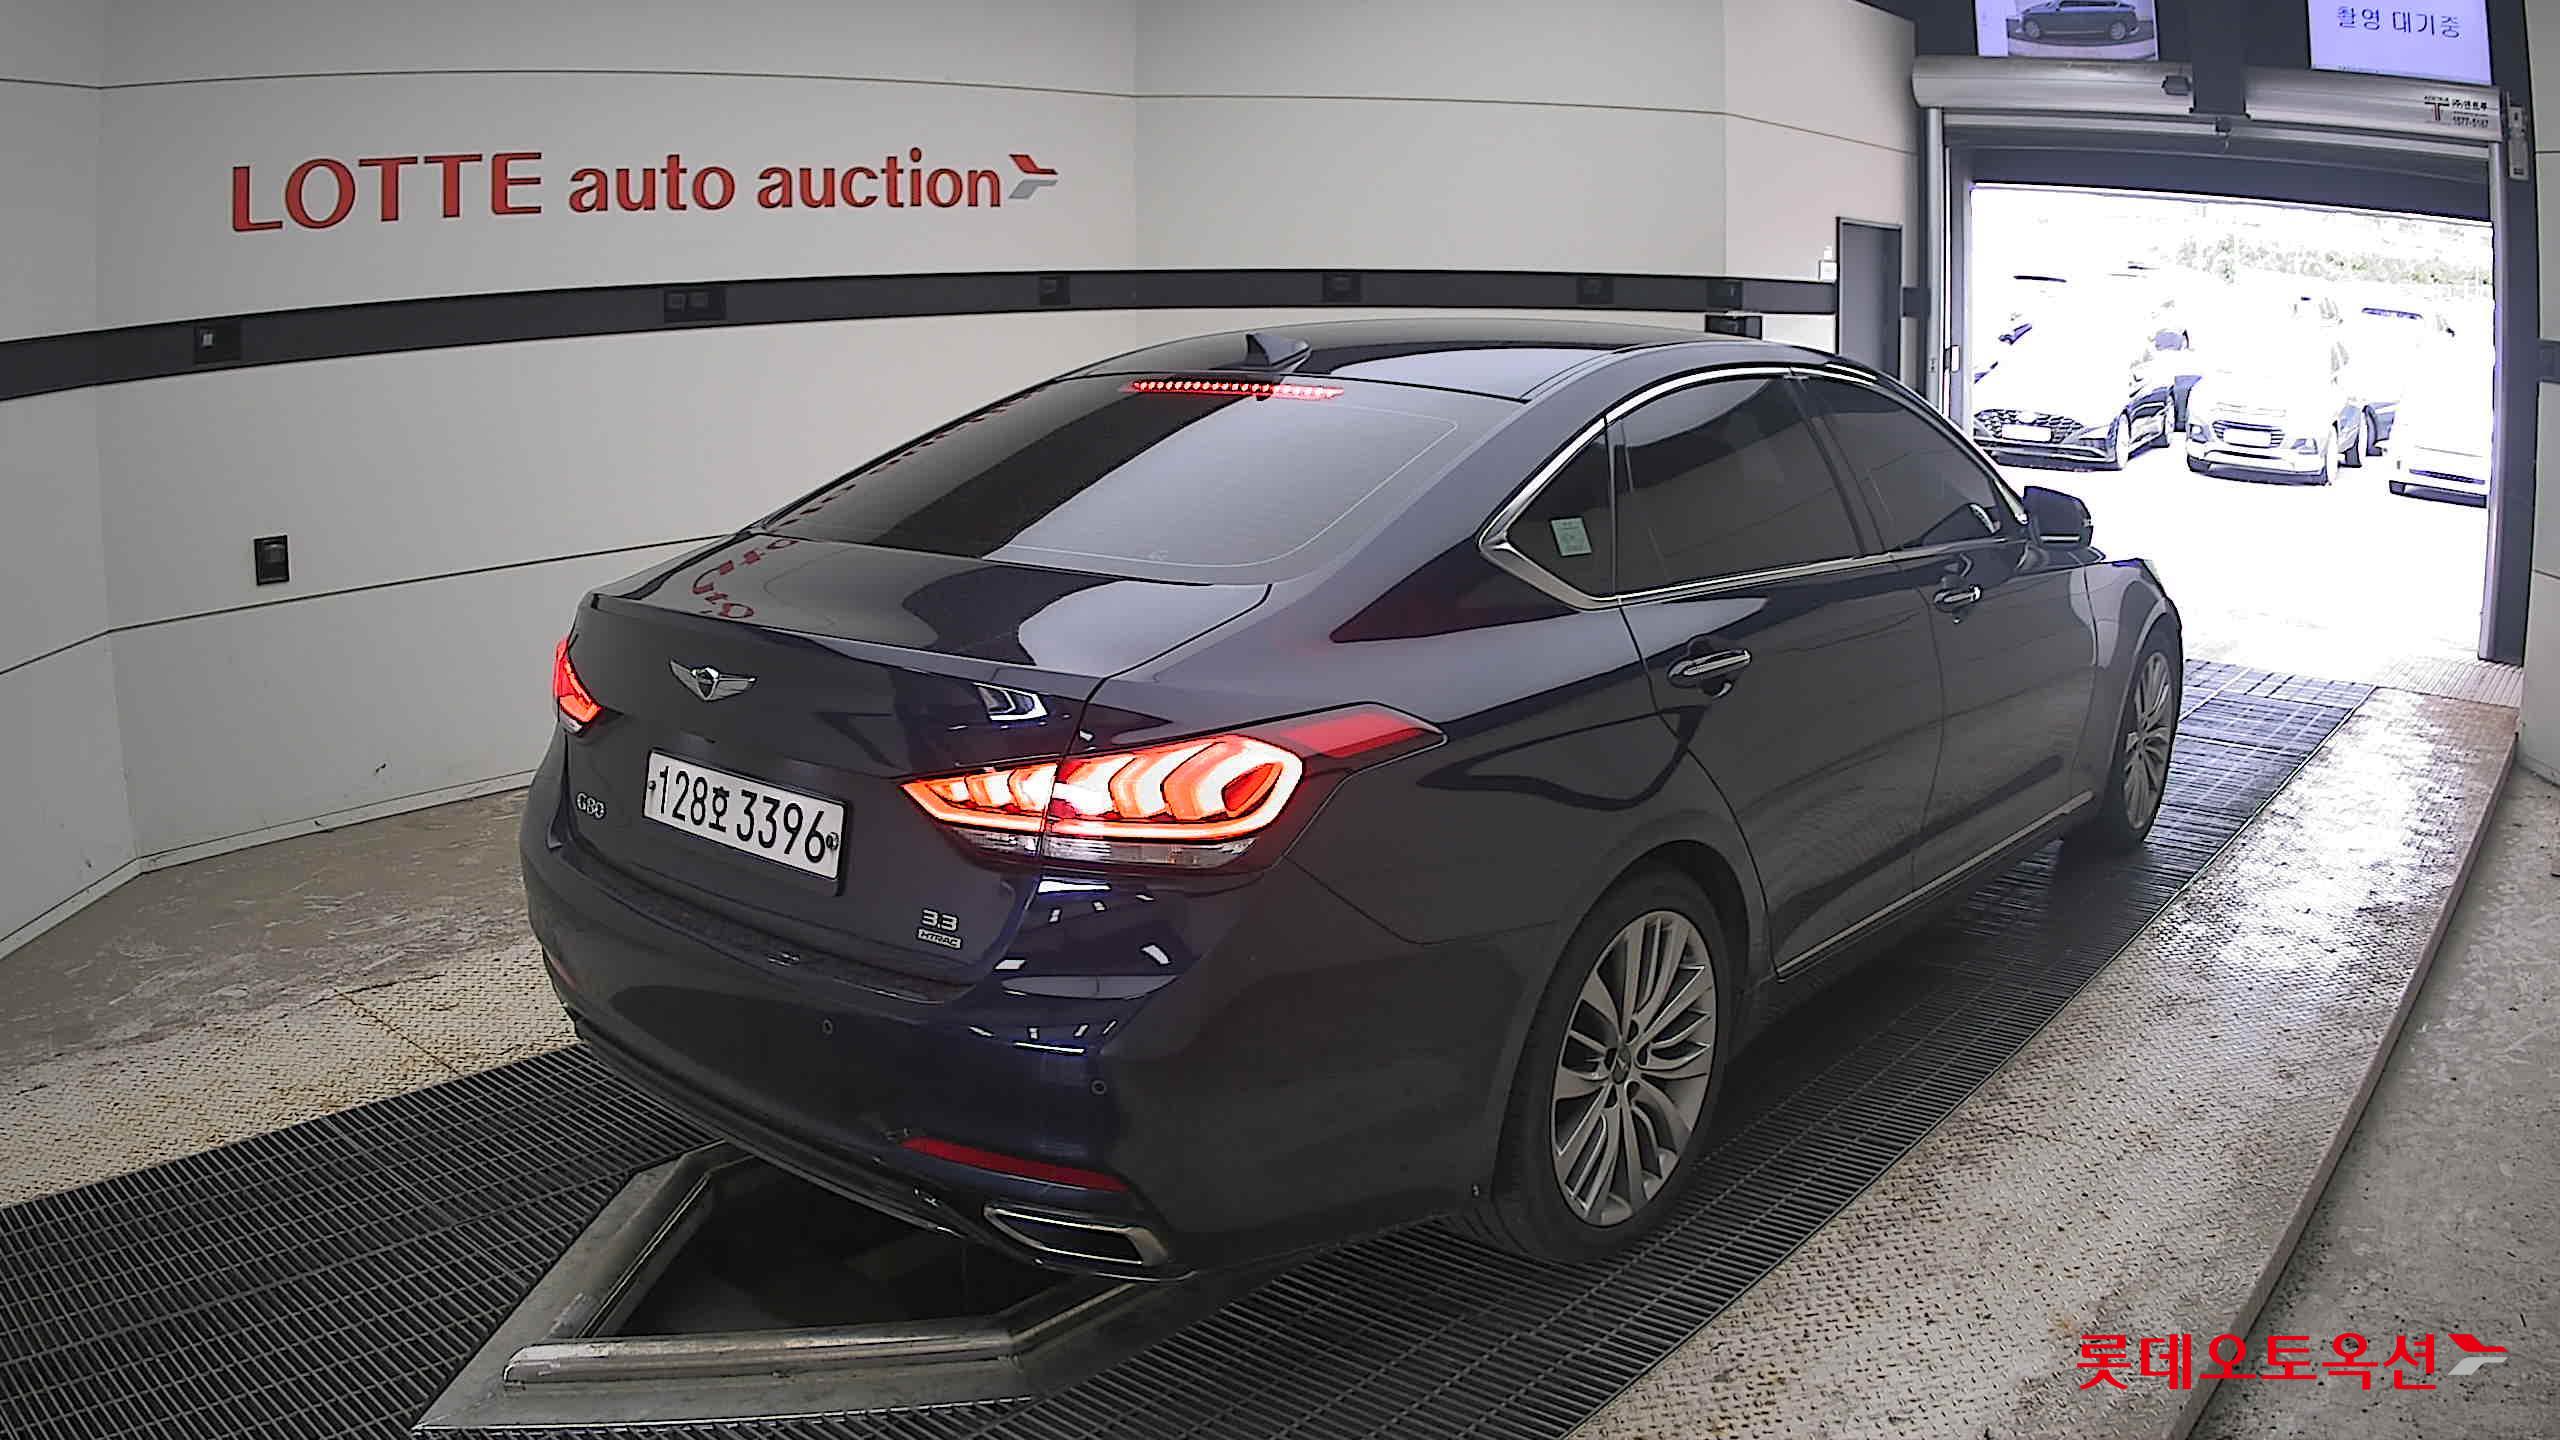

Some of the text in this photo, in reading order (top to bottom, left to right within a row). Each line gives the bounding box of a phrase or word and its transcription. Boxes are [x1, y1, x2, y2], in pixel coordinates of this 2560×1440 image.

[2392, 11, 2461, 38] 대기중
[232, 148, 1001, 232] LOTTE auto auction
[922, 909, 958, 931] 3.3
